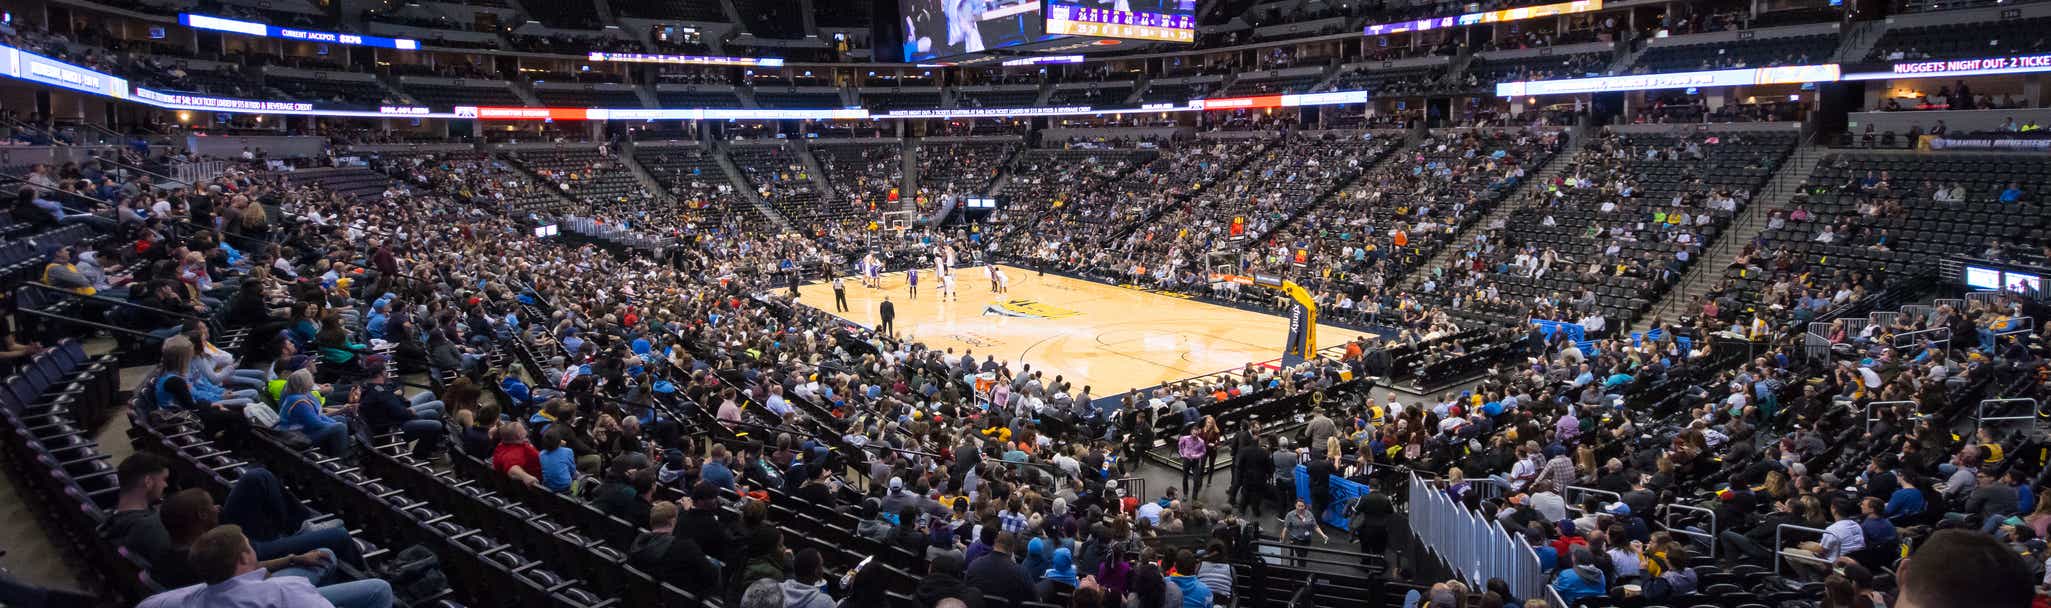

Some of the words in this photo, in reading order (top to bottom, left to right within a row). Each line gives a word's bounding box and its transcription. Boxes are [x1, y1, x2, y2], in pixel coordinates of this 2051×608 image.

[1114, 15, 1118, 23] 0
[282, 29, 307, 39] CURRENT
[308, 32, 336, 41] JACKPOT:
[1894, 62, 1945, 73] NUGGETS
[1948, 60, 1981, 70] NIGHT
[1983, 58, 2008, 69] OUT-
[2011, 58, 2017, 67] 2
[2020, 55, 2051, 66] TICKE
[1291, 304, 1300, 333] xfinity
